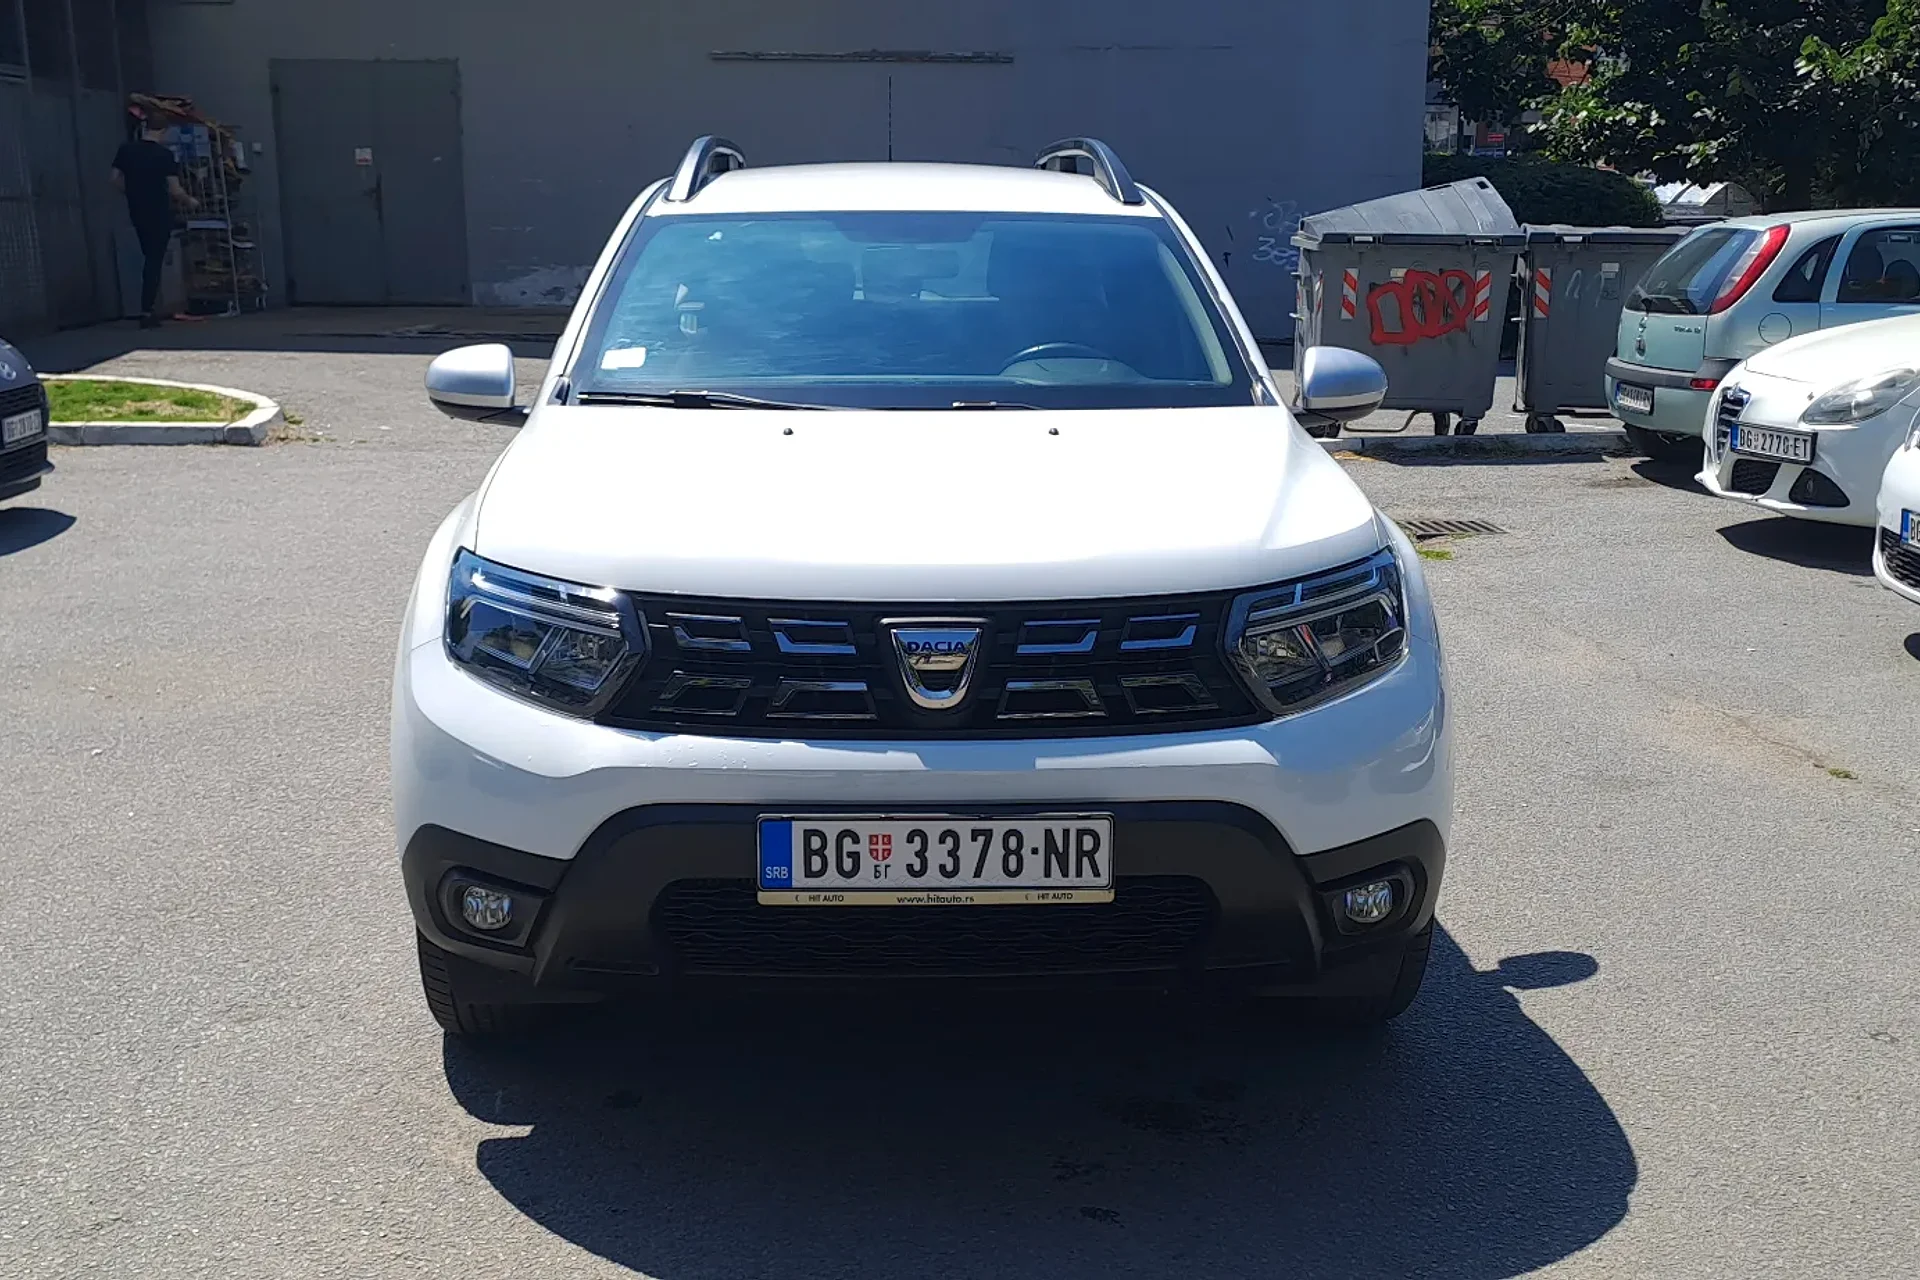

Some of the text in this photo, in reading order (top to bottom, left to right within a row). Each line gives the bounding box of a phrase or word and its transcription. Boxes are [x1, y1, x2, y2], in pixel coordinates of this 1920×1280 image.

[907, 641, 968, 652] DACIA
[803, 828, 861, 879] BG
[765, 866, 789, 879] SRB
[822, 894, 844, 902] AUTO
[896, 893, 975, 904] www.hitauto.rs
[1051, 892, 1074, 900] AUTO
